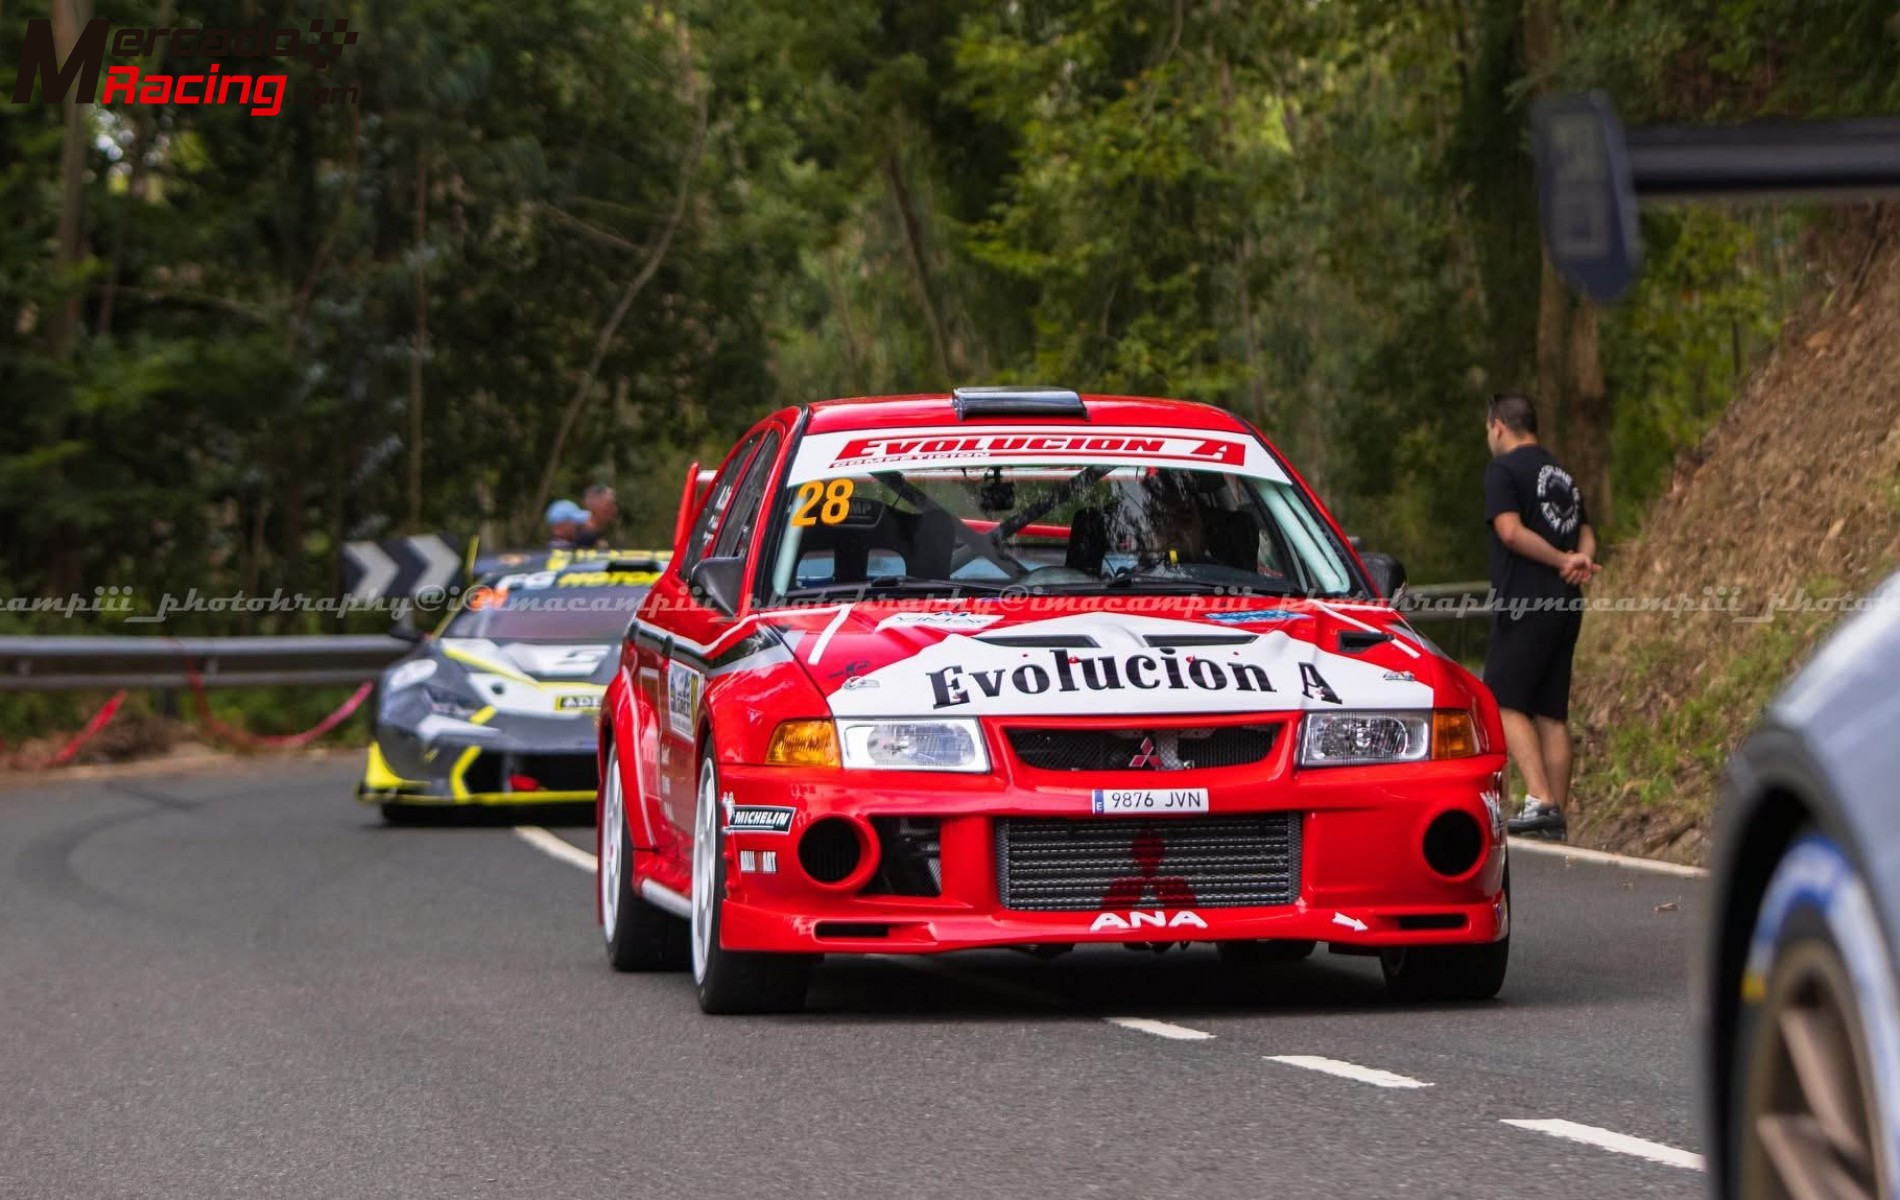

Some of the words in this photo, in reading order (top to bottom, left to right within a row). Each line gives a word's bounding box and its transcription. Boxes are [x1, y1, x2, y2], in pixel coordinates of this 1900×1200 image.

[835, 437, 1166, 460] EVOLUCION
[1190, 439, 1246, 467] A
[791, 478, 854, 527] 28
[926, 648, 1277, 709] Evolucion
[1298, 661, 1343, 706] A
[1112, 791, 1155, 808] 9876
[1164, 790, 1201, 808] JVN
[734, 811, 792, 828] MICHELIN
[1090, 910, 1208, 931] ANA
